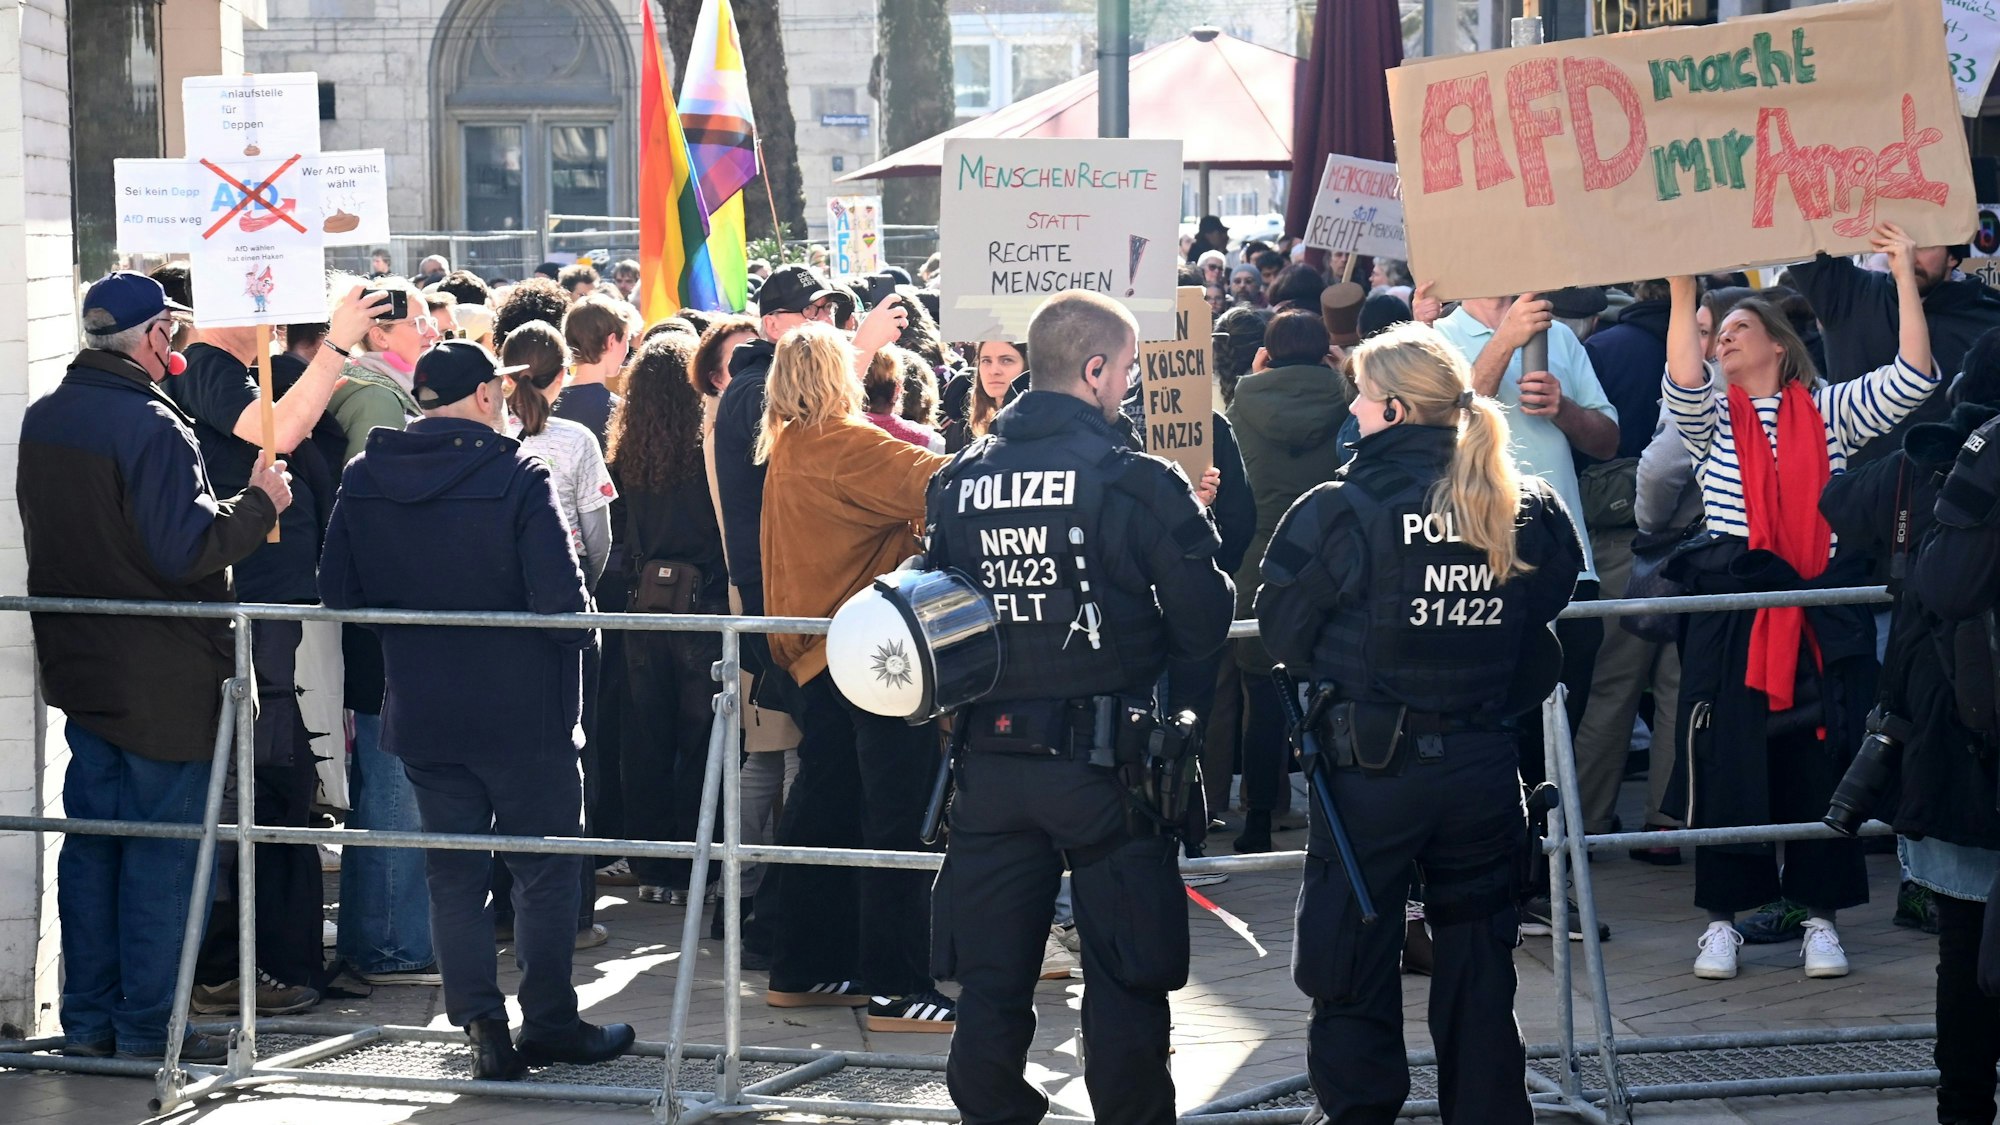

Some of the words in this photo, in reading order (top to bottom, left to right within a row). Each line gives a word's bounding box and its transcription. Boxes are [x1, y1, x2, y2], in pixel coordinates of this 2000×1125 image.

[1648, 27, 1817, 101] macht
[220, 88, 283, 99] Anlaufstelle
[221, 104, 237, 114] für
[223, 119, 264, 131] Deppen
[302, 167, 322, 176] Wer
[326, 166, 345, 175] AfD
[1751, 93, 1949, 238] Angst
[125, 187, 142, 196] Sei
[145, 186, 168, 196] kein
[171, 187, 200, 199] Depp
[210, 180, 279, 212] AfD
[328, 179, 356, 189] wählt
[123, 214, 144, 224] AfD
[147, 216, 177, 224] muss
[180, 216, 202, 226] weg
[1026, 212, 1091, 231] STATT
[1309, 215, 1366, 252] RECHTE
[988, 240, 1071, 266] RECHTE
[991, 269, 1113, 295] MENSCHEN
[1147, 349, 1206, 381] KÖLSCH
[1150, 387, 1182, 415] FÜR
[1152, 421, 1203, 450] NAZIS
[958, 470, 1076, 513] POLIZEI
[980, 526, 1047, 556] NRW
[1897, 522, 1906, 543] EOS
[980, 557, 1057, 589] 31423
[1424, 564, 1495, 592] NRW
[993, 593, 1046, 621] FLT
[1409, 597, 1503, 626] 31422
